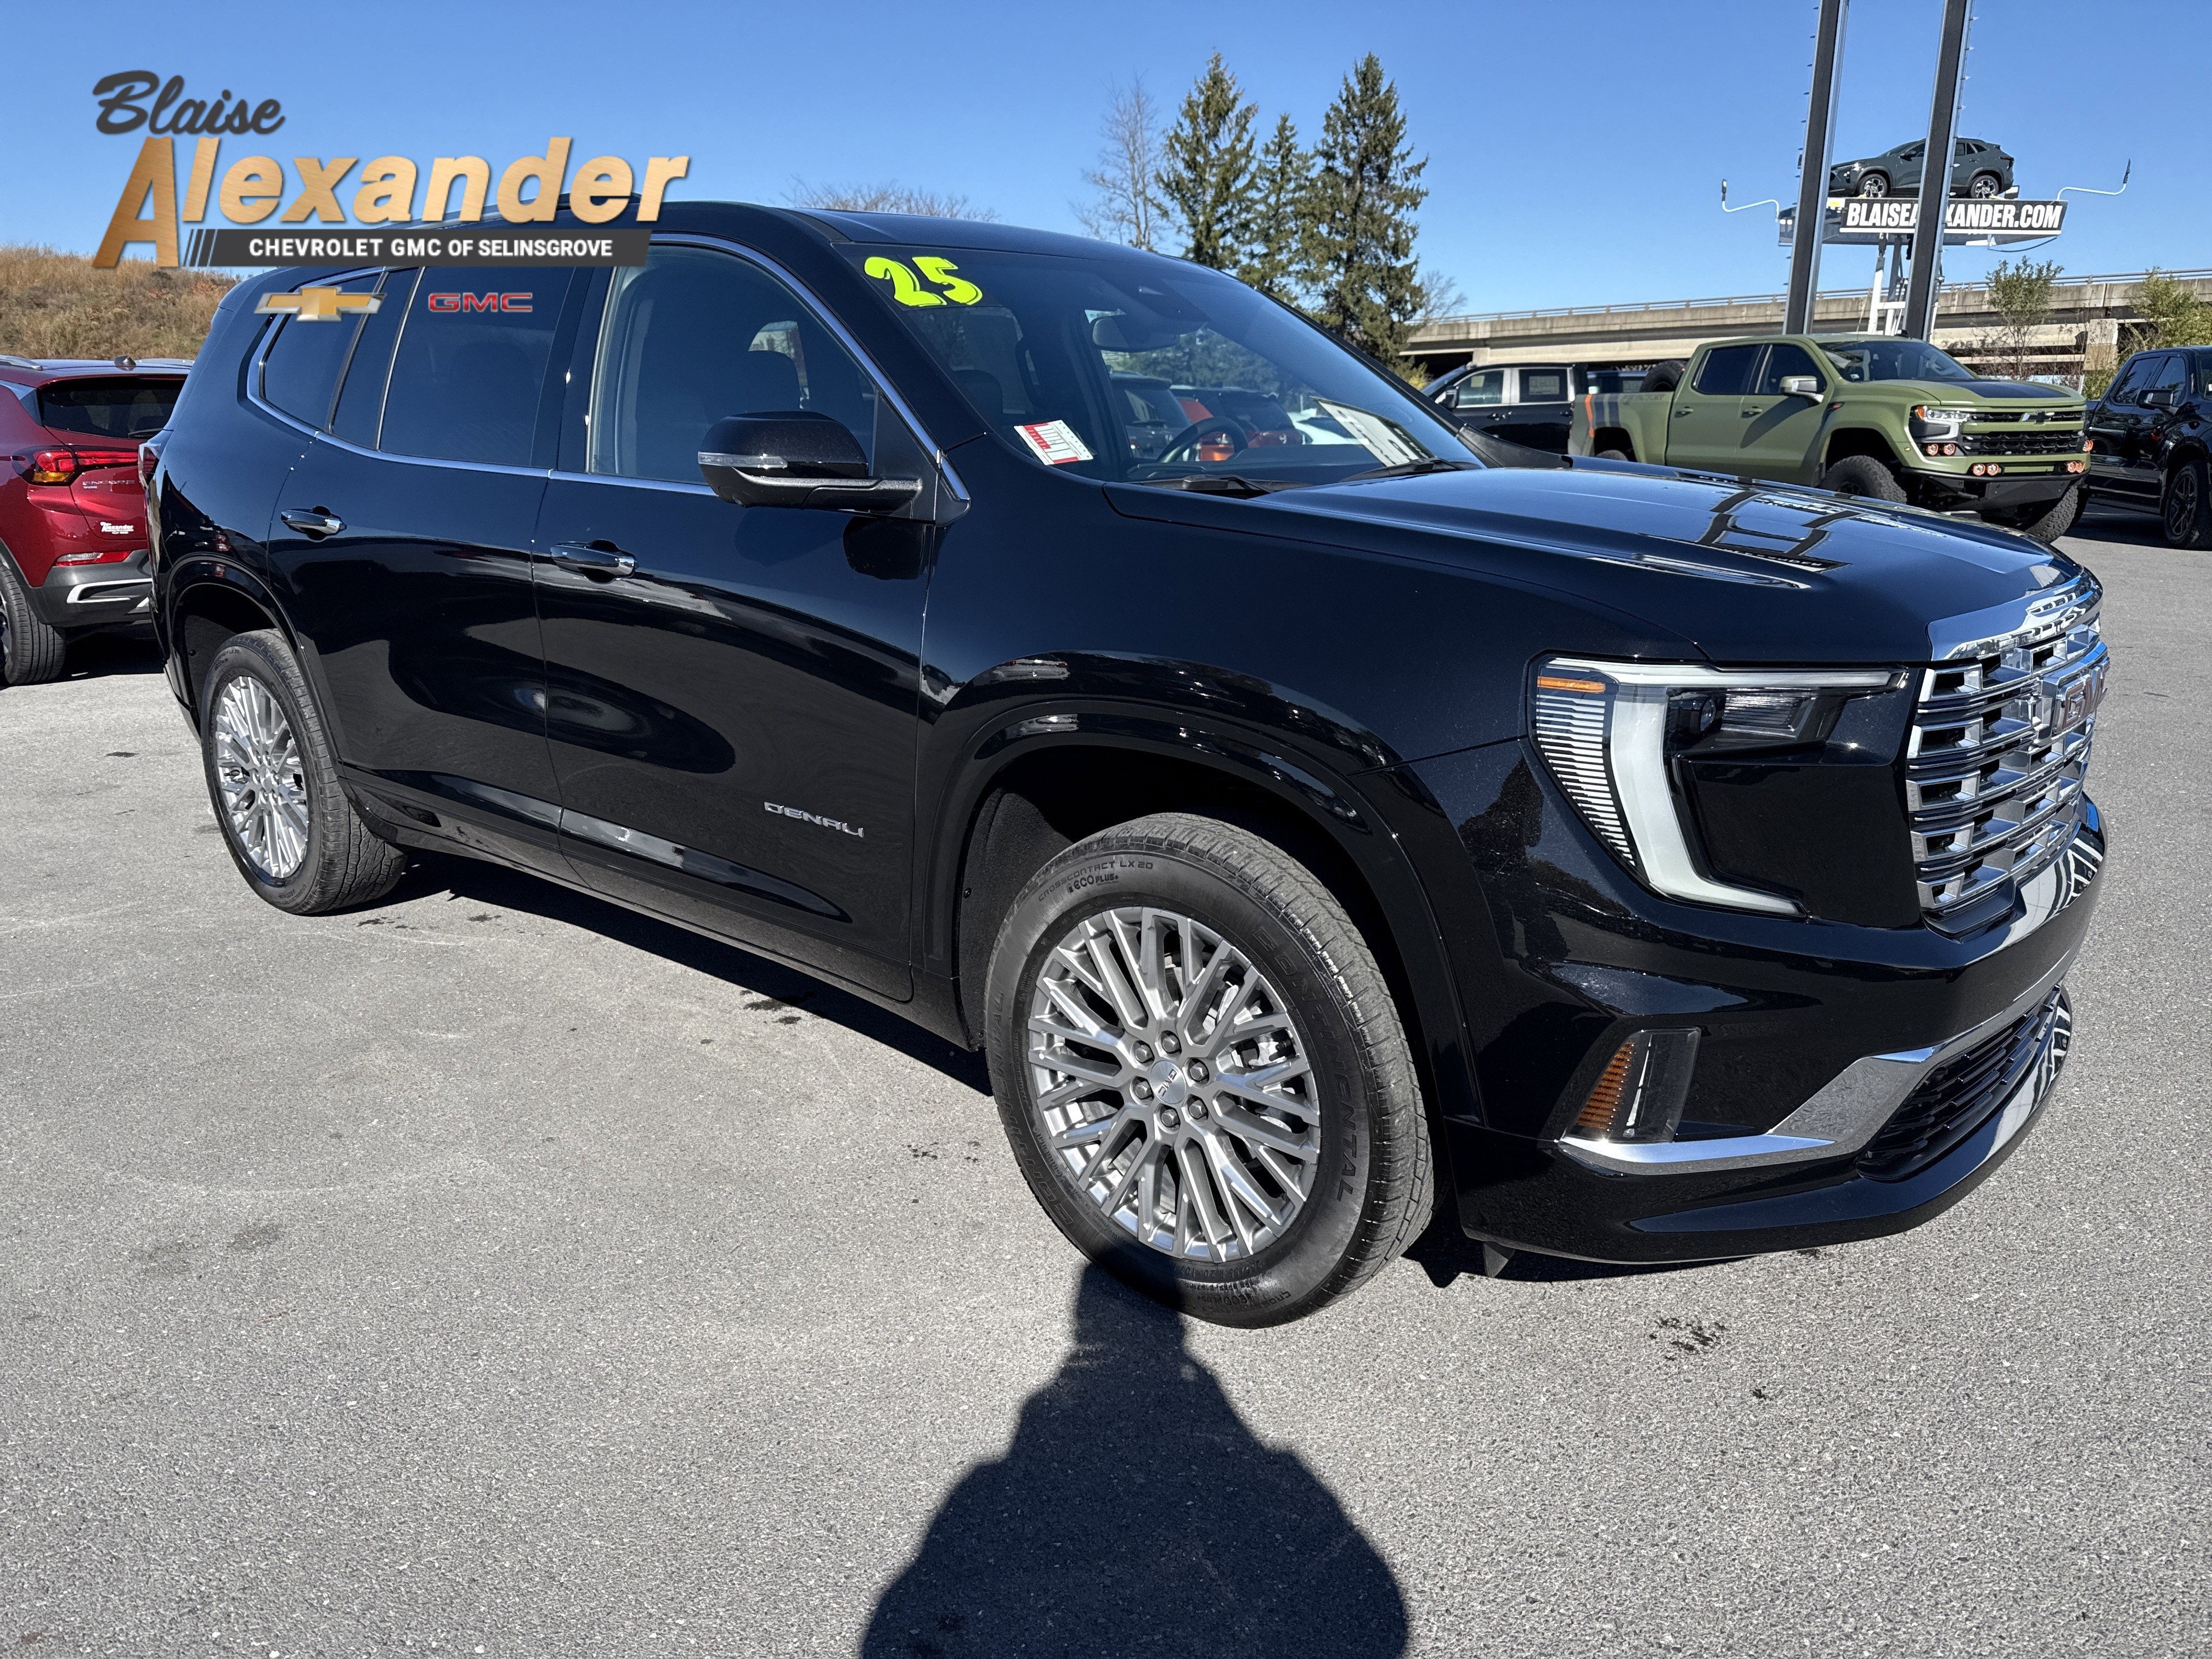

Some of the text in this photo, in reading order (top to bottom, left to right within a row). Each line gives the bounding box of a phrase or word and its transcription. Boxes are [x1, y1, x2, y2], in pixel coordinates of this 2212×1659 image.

[1846, 202, 2063, 228] BLAISEAXANDER.COM
[864, 256, 983, 306] 25
[764, 801, 865, 838] DENALI
[1037, 860, 1116, 902] CROSSCONTACT
[1158, 1068, 1177, 1097] GMC
[1251, 927, 1356, 1204] CONTINENTAL
